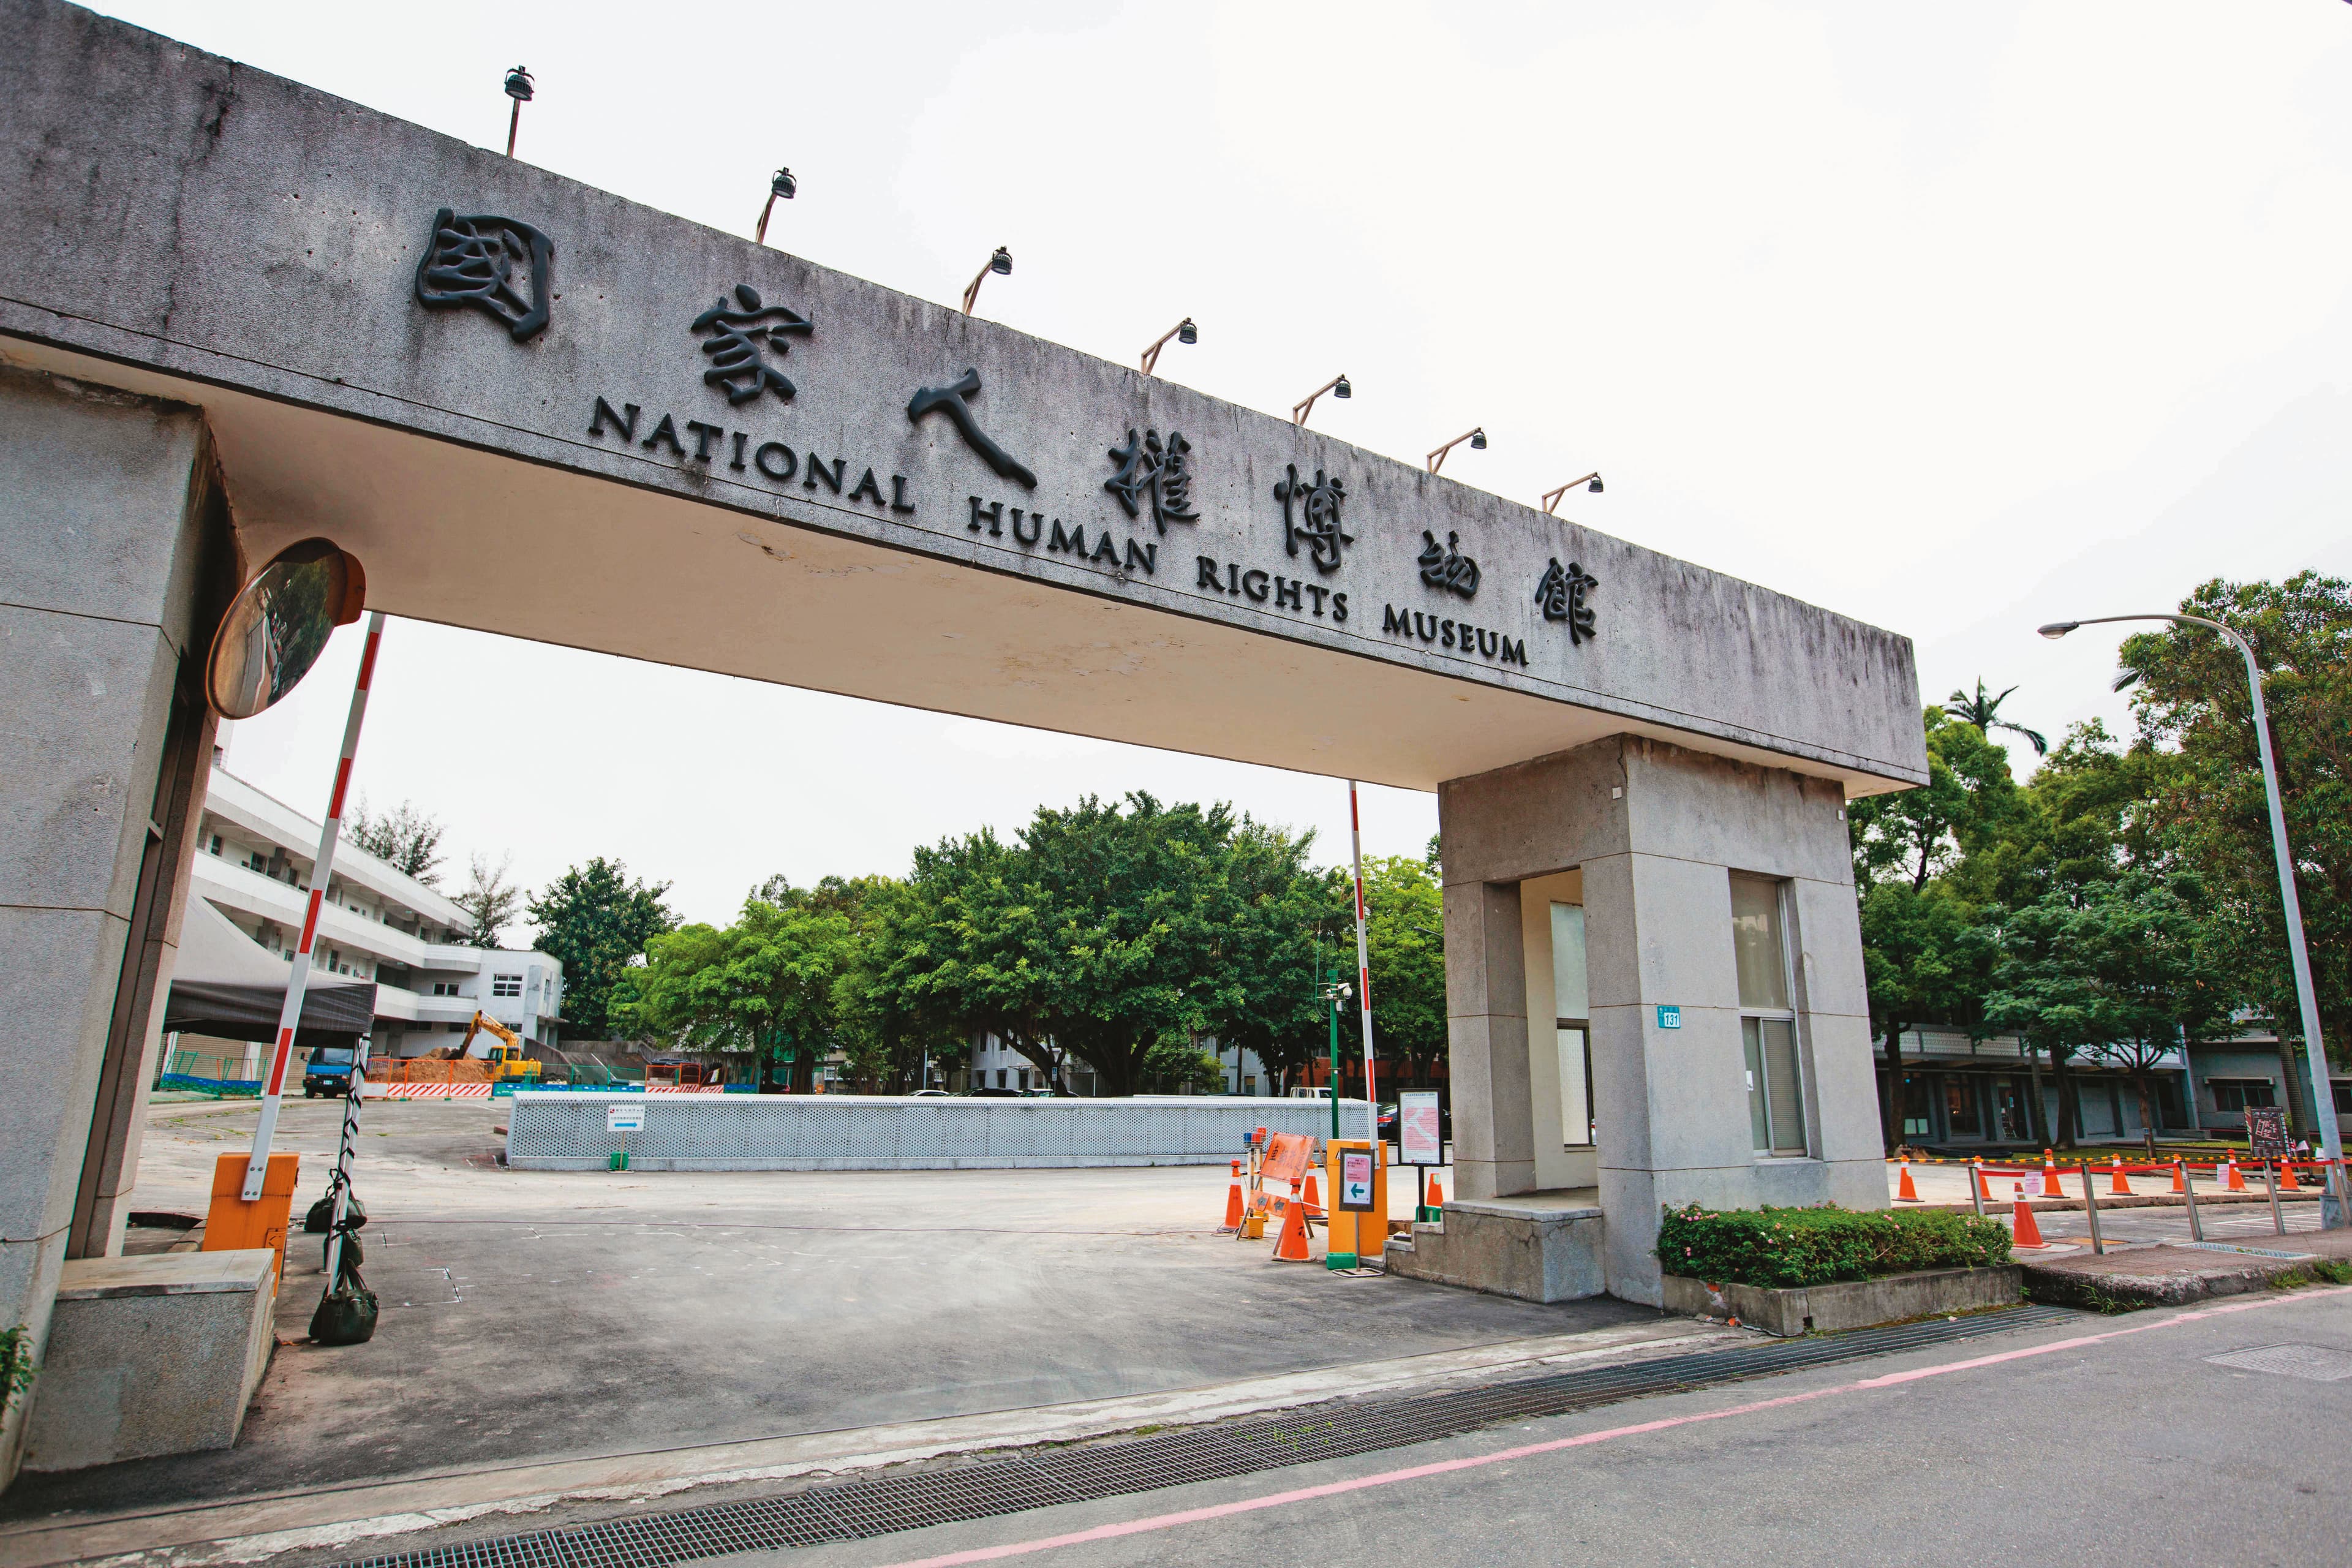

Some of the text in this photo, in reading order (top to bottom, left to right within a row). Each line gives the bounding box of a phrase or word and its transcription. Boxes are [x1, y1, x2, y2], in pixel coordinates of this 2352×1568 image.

[415, 208, 1599, 645] 國家人權博物館
[588, 396, 1530, 666] NATIONAL HUMAN RIGHTS MUSEUM
[1665, 1014, 1678, 1025] 131
